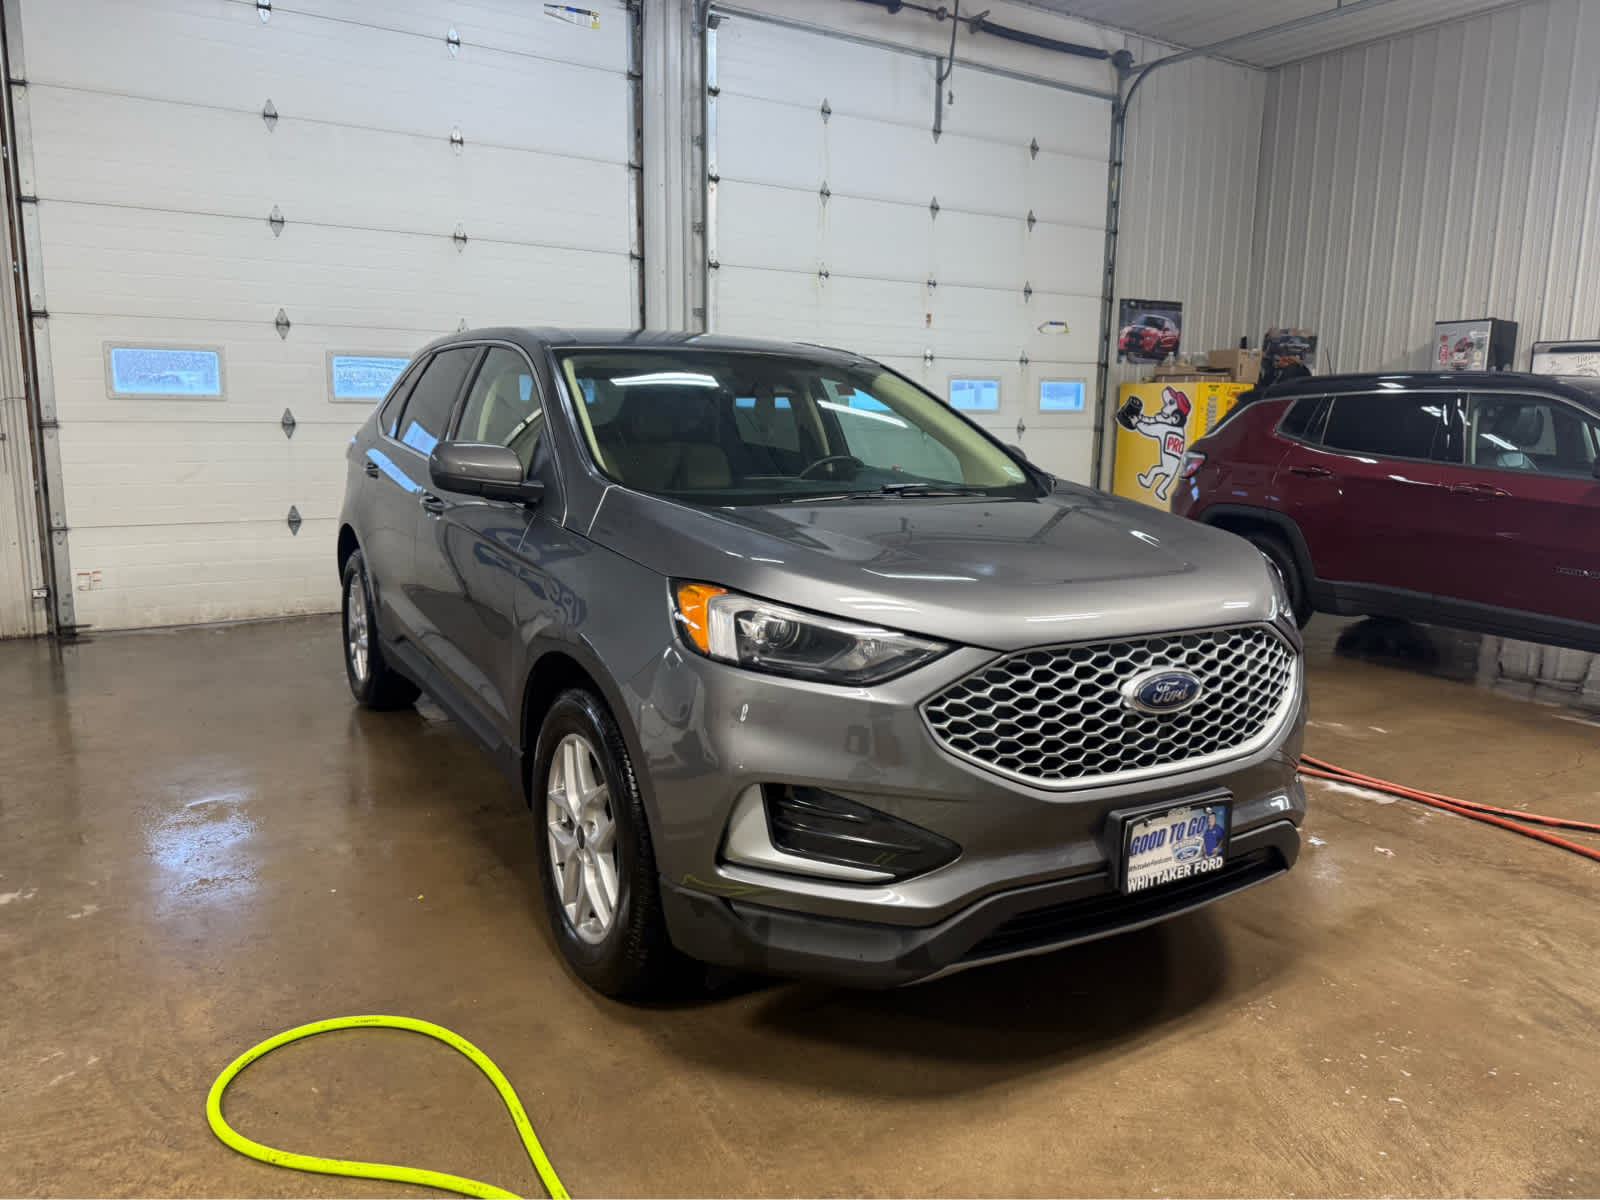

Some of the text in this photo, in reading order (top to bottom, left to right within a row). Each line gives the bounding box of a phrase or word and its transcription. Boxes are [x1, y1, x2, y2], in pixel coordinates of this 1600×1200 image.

[1153, 680, 1189, 704] Ford
[1129, 828, 1167, 857] GOOD
[1169, 822, 1186, 844] TO
[1187, 815, 1208, 838] GO
[1128, 865, 1191, 894] WHITTAKER
[1194, 857, 1224, 875] FORD
